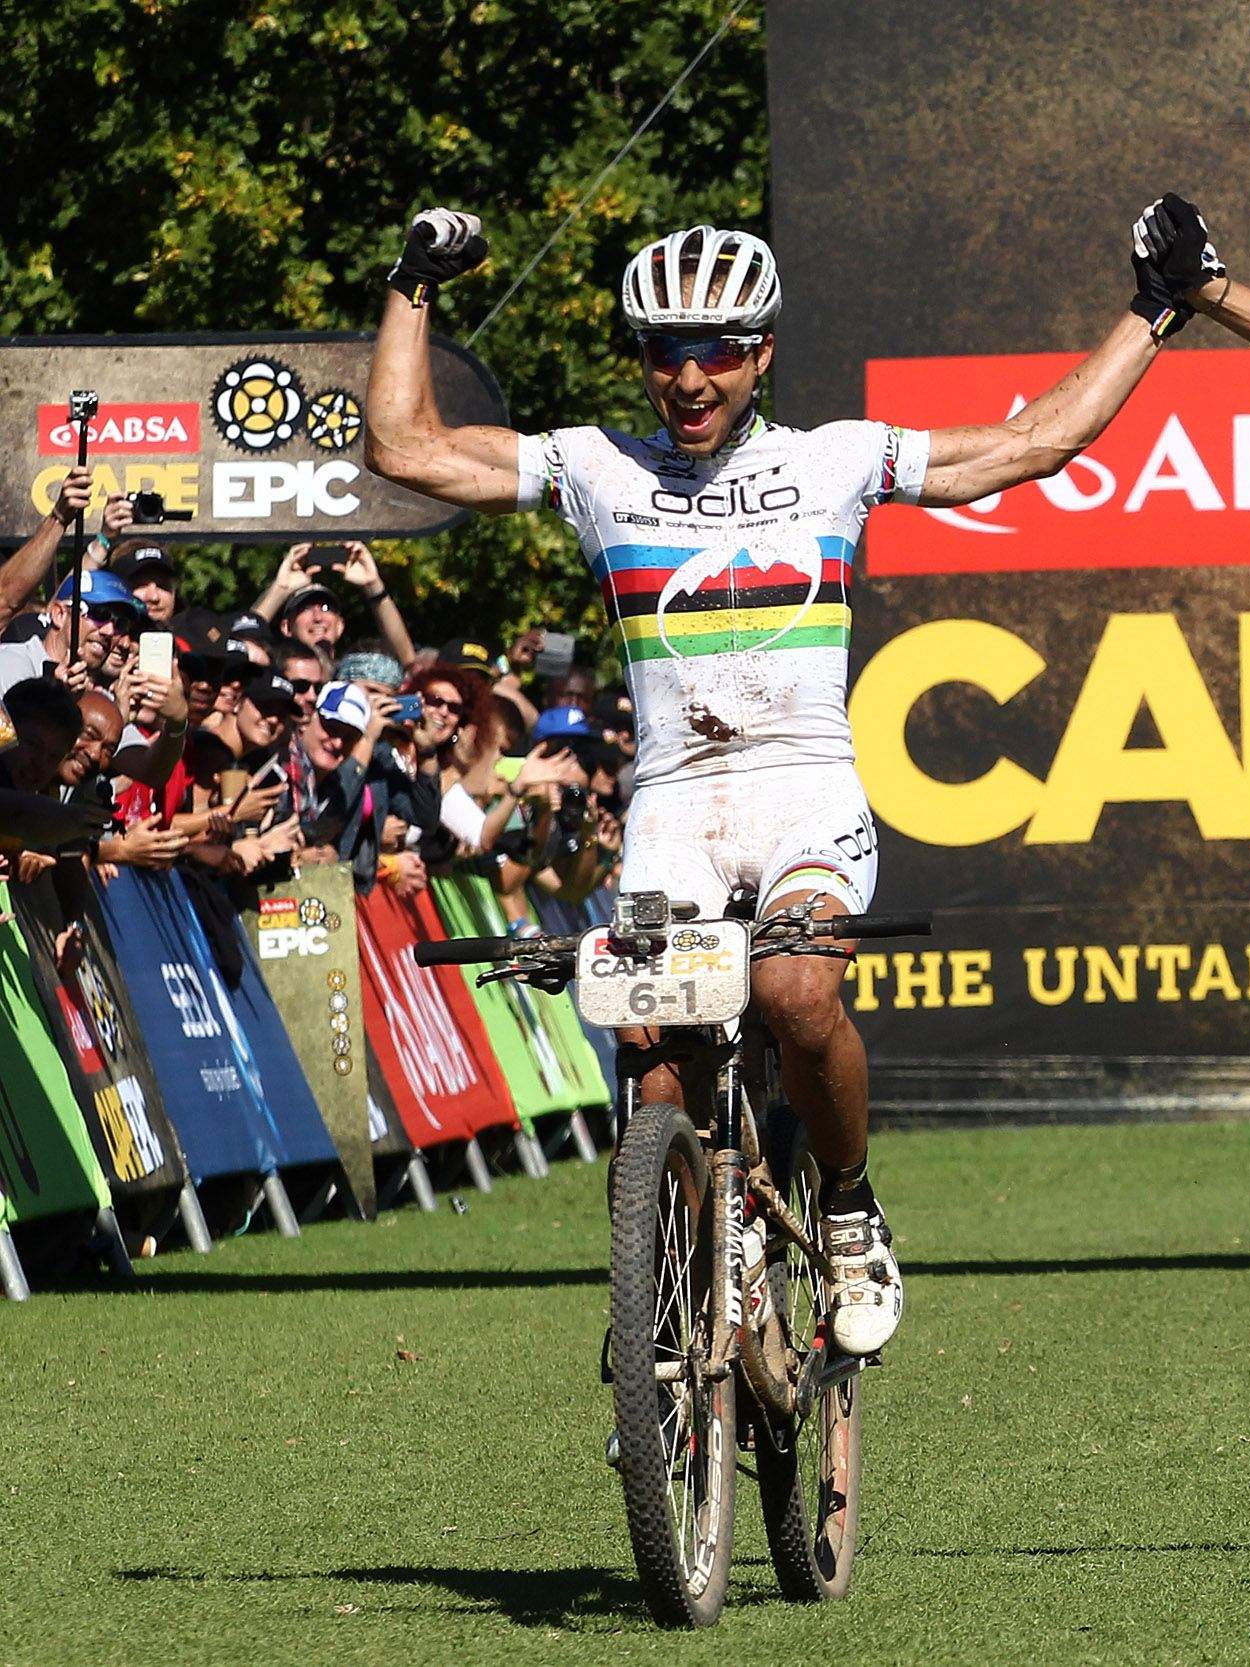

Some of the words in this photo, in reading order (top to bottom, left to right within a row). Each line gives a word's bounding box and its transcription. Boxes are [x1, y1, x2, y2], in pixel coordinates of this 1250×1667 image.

[99, 415, 188, 443] ABSA
[212, 459, 360, 519] EPIC
[258, 926, 330, 959] EPIC
[671, 950, 734, 975] EPIC
[629, 980, 697, 1016] 6-1
[843, 950, 994, 1011] THE
[724, 1190, 744, 1268] SWISS
[724, 1278, 743, 1327] DT
